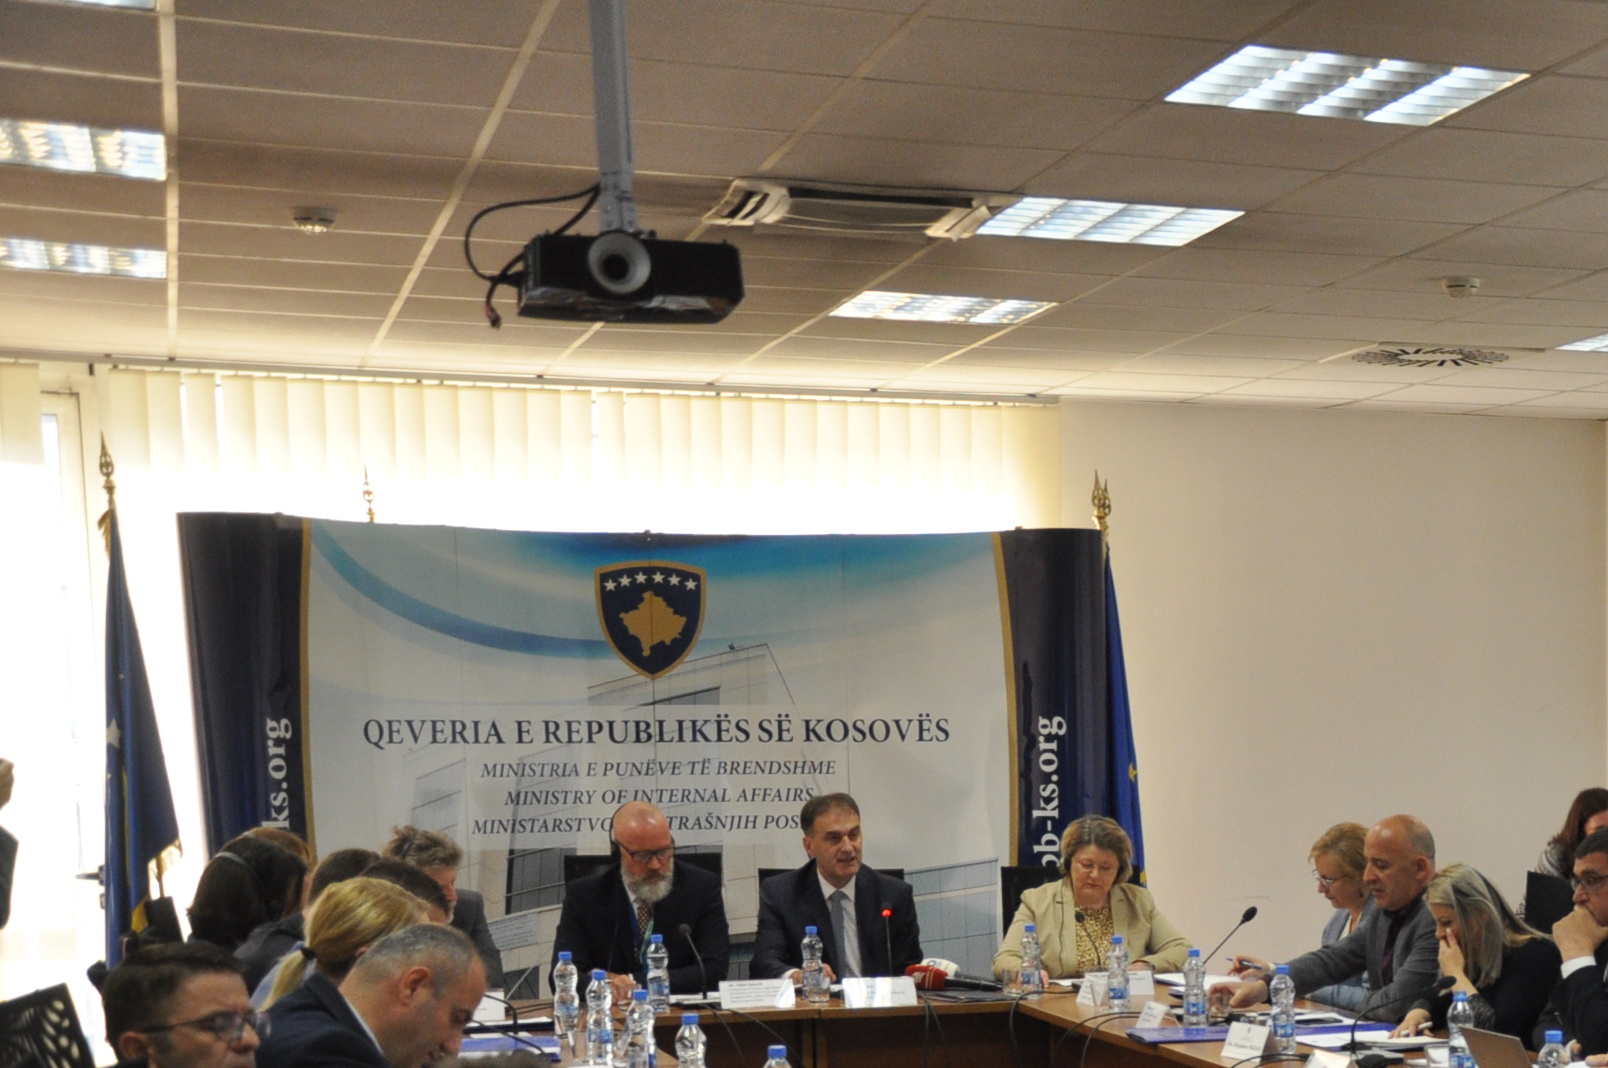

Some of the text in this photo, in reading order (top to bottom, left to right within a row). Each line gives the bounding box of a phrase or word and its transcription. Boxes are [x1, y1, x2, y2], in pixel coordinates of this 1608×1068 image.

[364, 713, 950, 750] QEVERIA E REPUBLIKËS SË KOSOVËS
[261, 718, 292, 830] ks.org
[480, 758, 837, 778] MINISTRIA E PUNËVE TË BRENDSHME
[504, 787, 815, 806] MINISTRY OF INTERNAL AFFAIRS
[1032, 715, 1068, 867] b-ks.org
[471, 817, 614, 835] MINISTARSTVO
[666, 812, 759, 833] TRAŠNJIH
